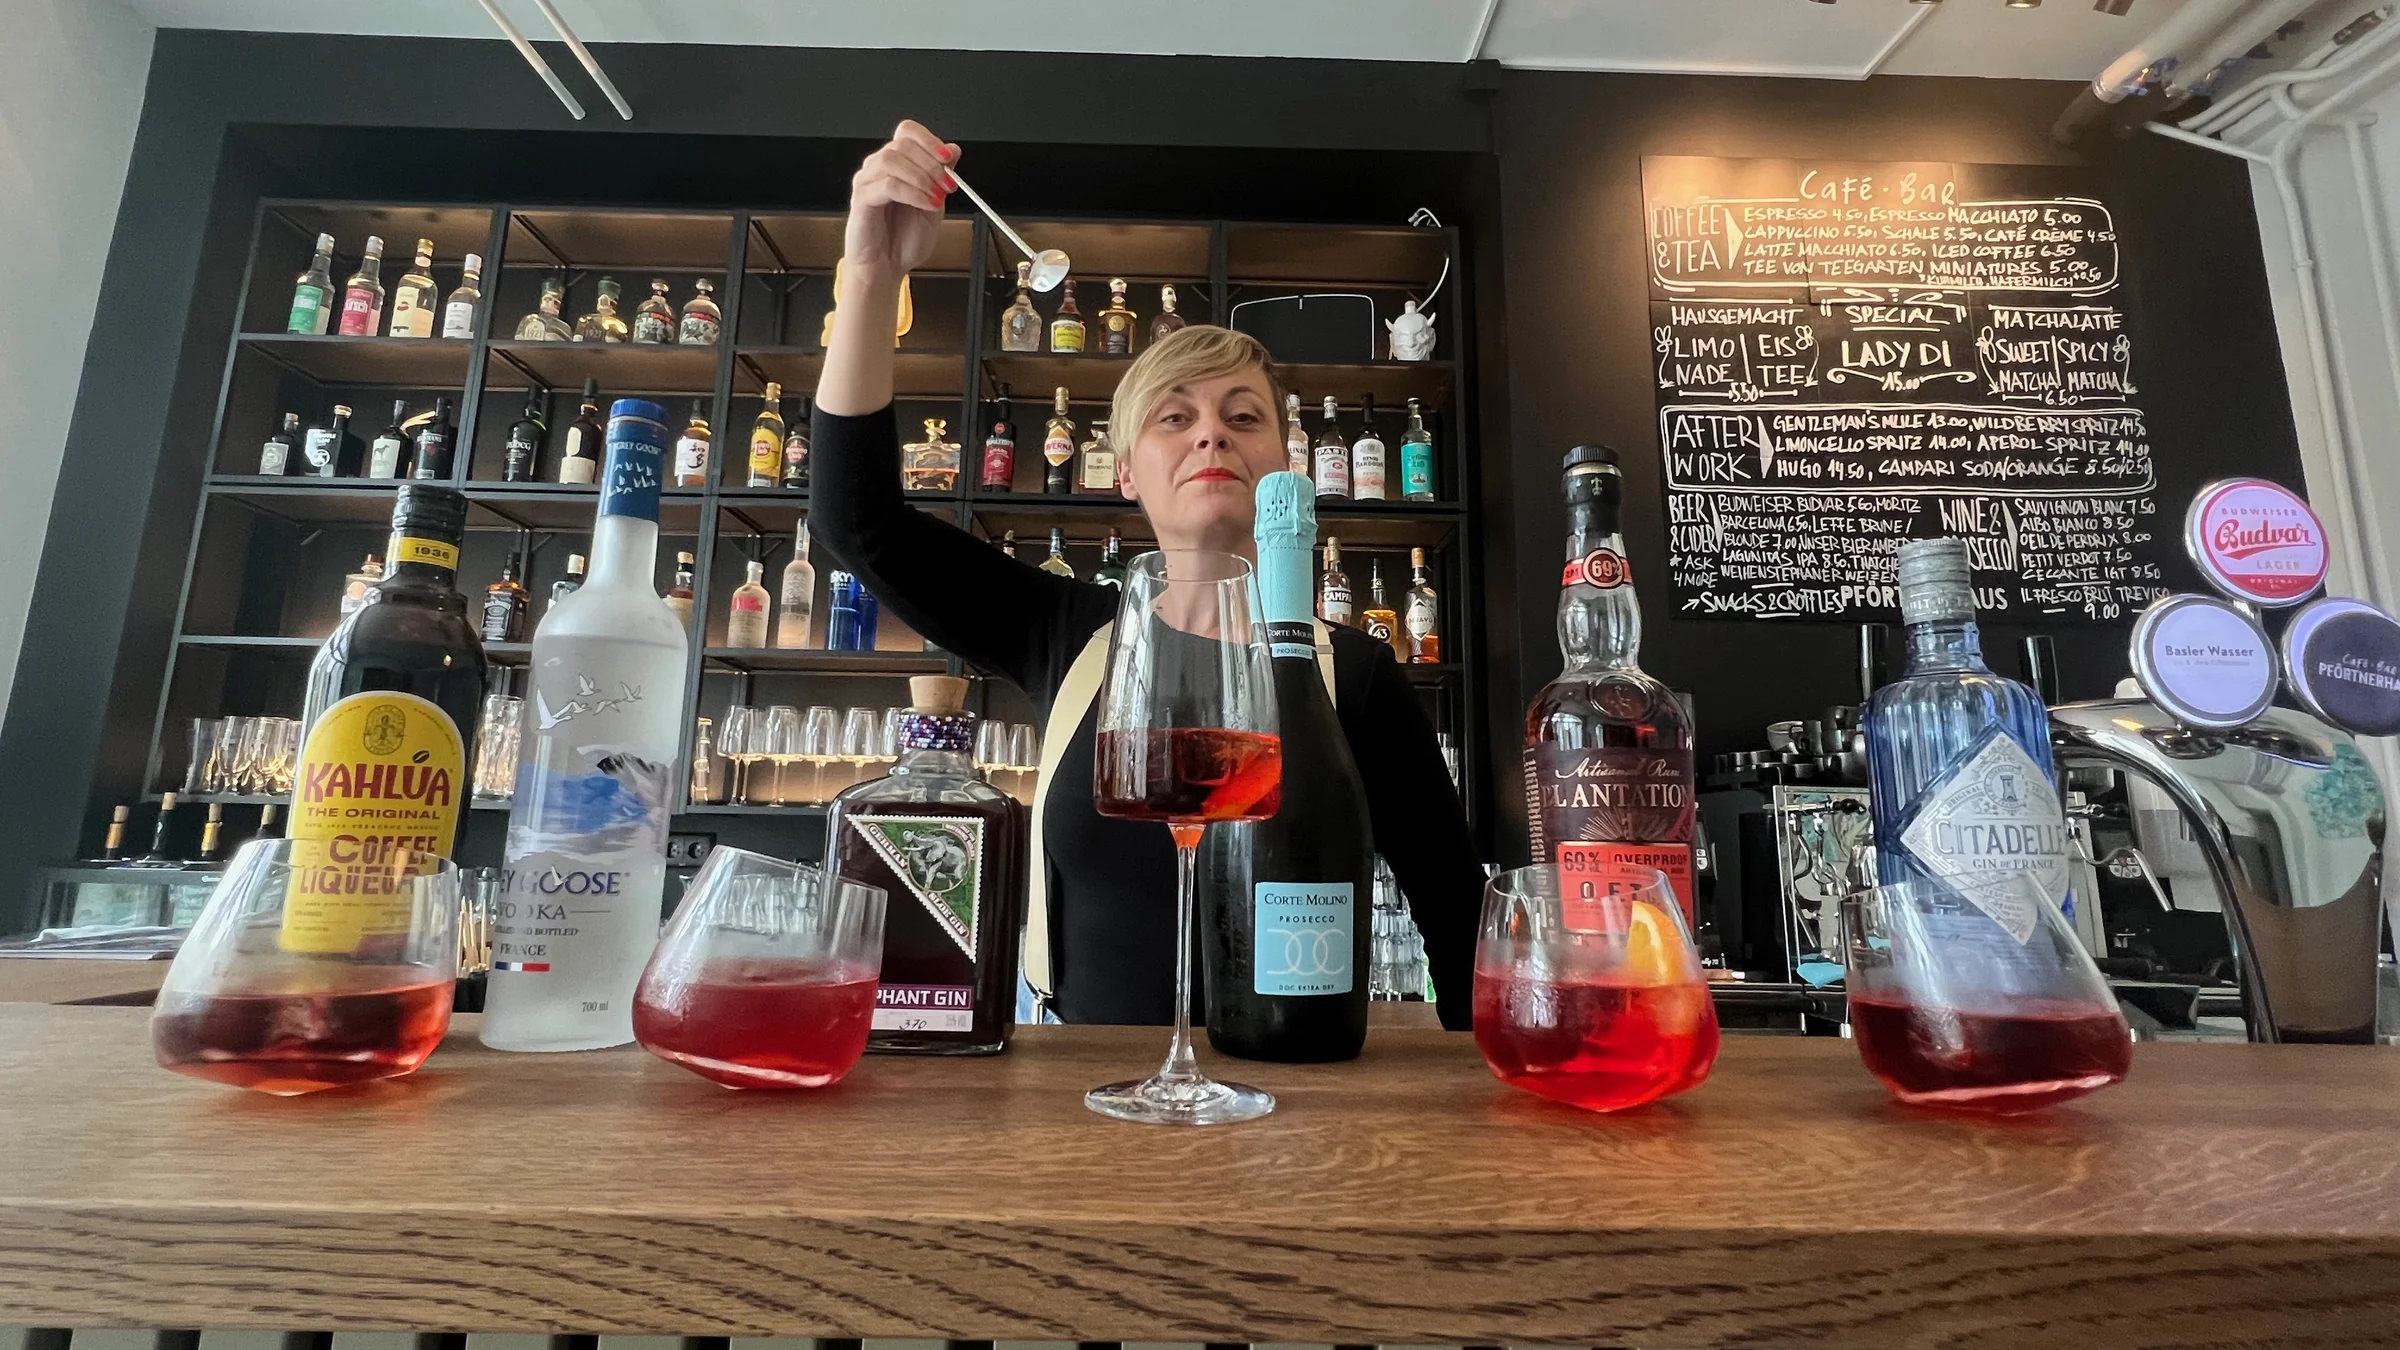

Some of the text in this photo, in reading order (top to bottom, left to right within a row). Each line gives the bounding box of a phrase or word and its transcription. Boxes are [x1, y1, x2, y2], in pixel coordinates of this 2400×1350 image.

[1653, 204, 1722, 239] COFFEE
[1743, 207, 1827, 222] ESPRESSO
[1869, 207, 1946, 222] ESPRESSO
[1949, 208, 2039, 225] MACCHIATO
[2044, 208, 2082, 226] 5.00
[1744, 225, 1839, 240] CAPPUCCINO
[1882, 225, 1940, 241] SCHALE
[1984, 224, 2027, 242] CAFÉ
[2031, 227, 2083, 243] CRÈME
[1744, 242, 1796, 257] LATTE
[1798, 242, 1886, 257] MACCHIATO
[1932, 244, 1970, 258] ICED
[1973, 244, 2037, 259] COFFEE
[1743, 258, 2090, 276] TEE VON TEEGARTEN MINIATURES 5.00
[1671, 306, 1804, 326] HAUSGEMACHT
[1675, 337, 1735, 358] LIMO
[1758, 334, 1797, 357] EIS
[1841, 340, 1952, 368] LADY DI
[1996, 338, 2051, 364] SWEET
[2057, 338, 2109, 364] SPICY
[1676, 363, 1735, 386] NADE
[1756, 364, 1806, 388] TEE
[1998, 370, 2058, 392] MATCHA
[2045, 389, 2079, 406] 6.50
[1673, 414, 1760, 449] AFTER
[1775, 436, 1866, 453] LIMONCELLO
[1868, 435, 1923, 451] SPRITZ
[1977, 435, 2043, 452] APEROL
[2046, 436, 2111, 456] SPRITZ
[1674, 452, 1751, 482] WORK
[1777, 459, 1822, 479] HUGO
[1878, 458, 1956, 477] CAMPARI
[1668, 494, 1709, 524] BEER
[1719, 495, 1795, 513] BUDWEISER
[1797, 497, 1846, 513] BUDVAR
[2014, 498, 2089, 517] SAUVIGNON
[2221, 507, 2298, 516] BUDWEISER
[1724, 532, 1770, 549] BLONDE
[2214, 519, 2317, 551] Budvar
[1722, 549, 1794, 566] LAGUNITAS
[1797, 552, 1818, 566] IPA
[2256, 561, 2300, 570] LAGER
[1701, 591, 1766, 612] SNACKS
[2084, 603, 2120, 620] 9.00
[2165, 645, 2254, 656] Basler Wasser
[1647, 759, 1681, 778] Rum
[307, 808, 440, 819] THE ORIGINAL
[1973, 858, 1997, 869] GIN
[2013, 858, 2054, 870] FRANCE
[1264, 893, 1348, 906] CORTE MOLINO
[534, 927, 579, 936] BOTTLED
[500, 943, 547, 957] FRANCE
[582, 1001, 597, 1012] 700
[934, 991, 967, 1006] GIN
